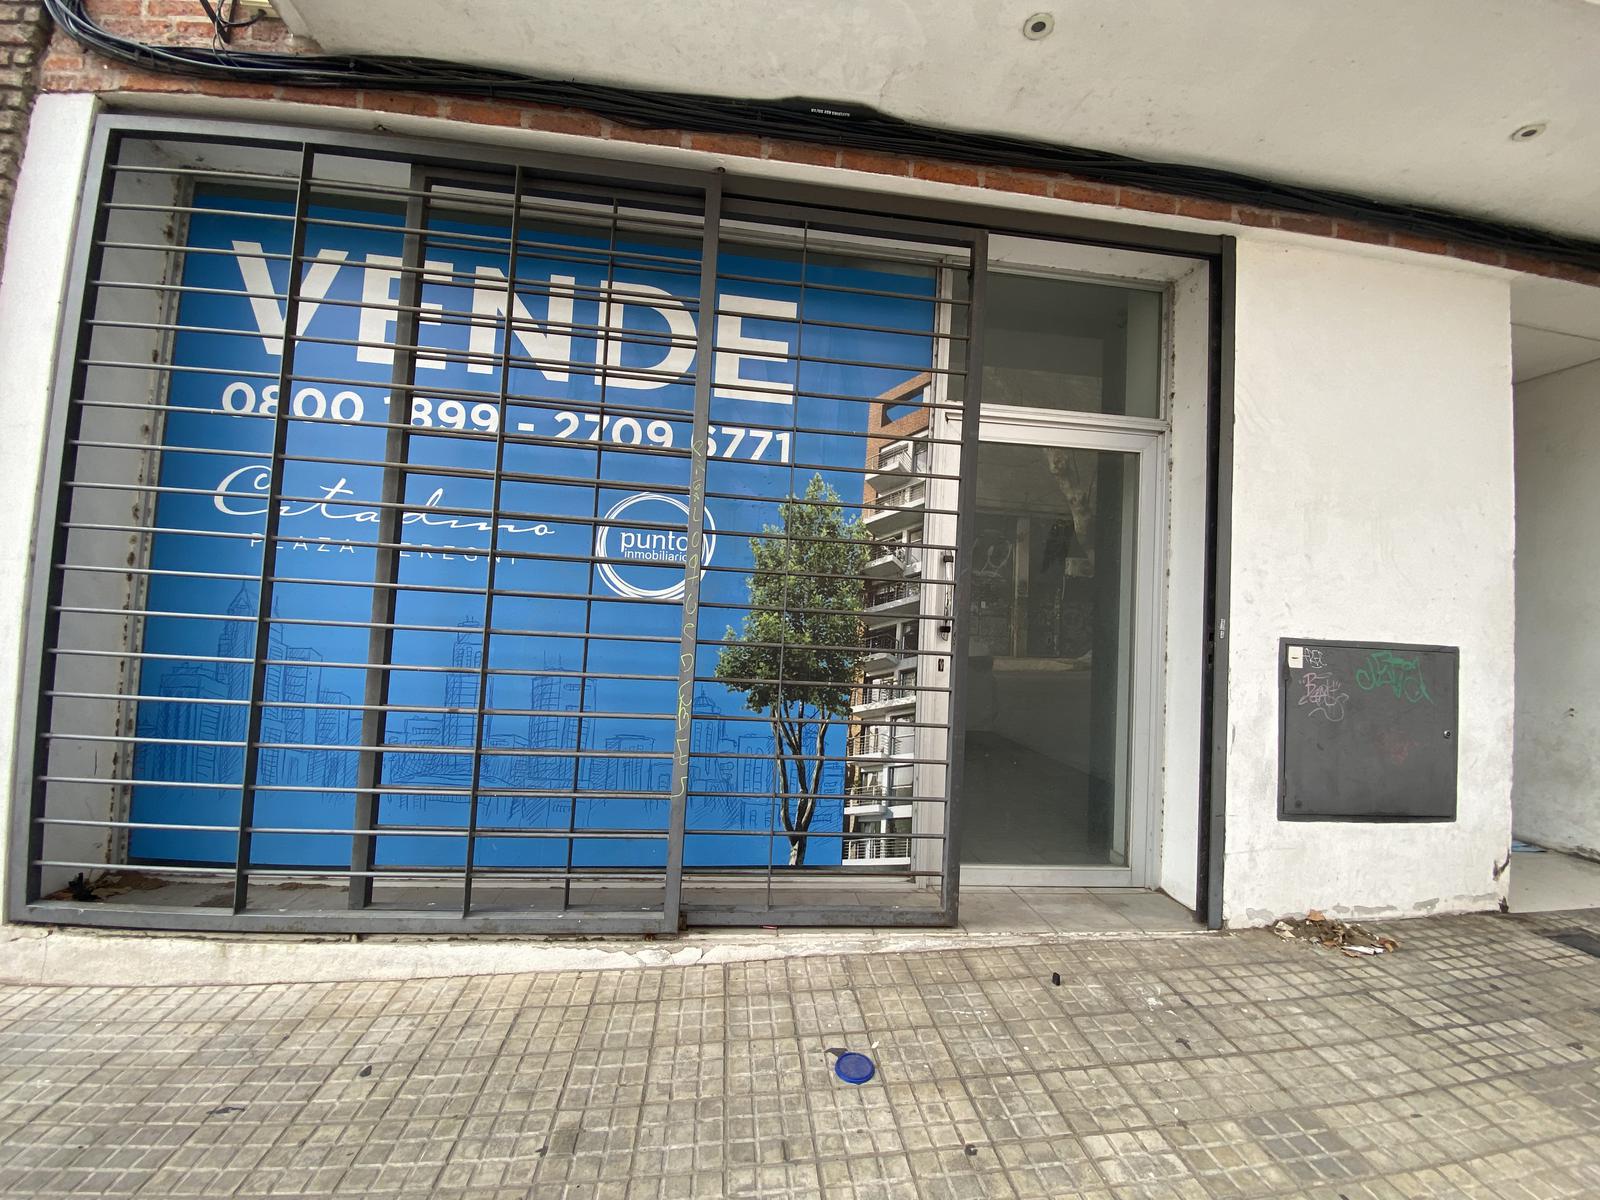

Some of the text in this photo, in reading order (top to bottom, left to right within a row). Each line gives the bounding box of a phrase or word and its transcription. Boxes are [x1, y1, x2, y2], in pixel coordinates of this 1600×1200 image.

[232, 240, 798, 405] VENDE
[221, 381, 365, 426] 0800
[383, 395, 499, 434] 899
[553, 411, 674, 450] 2709
[250, 532, 354, 554] PAZA
[620, 530, 688, 552] punto
